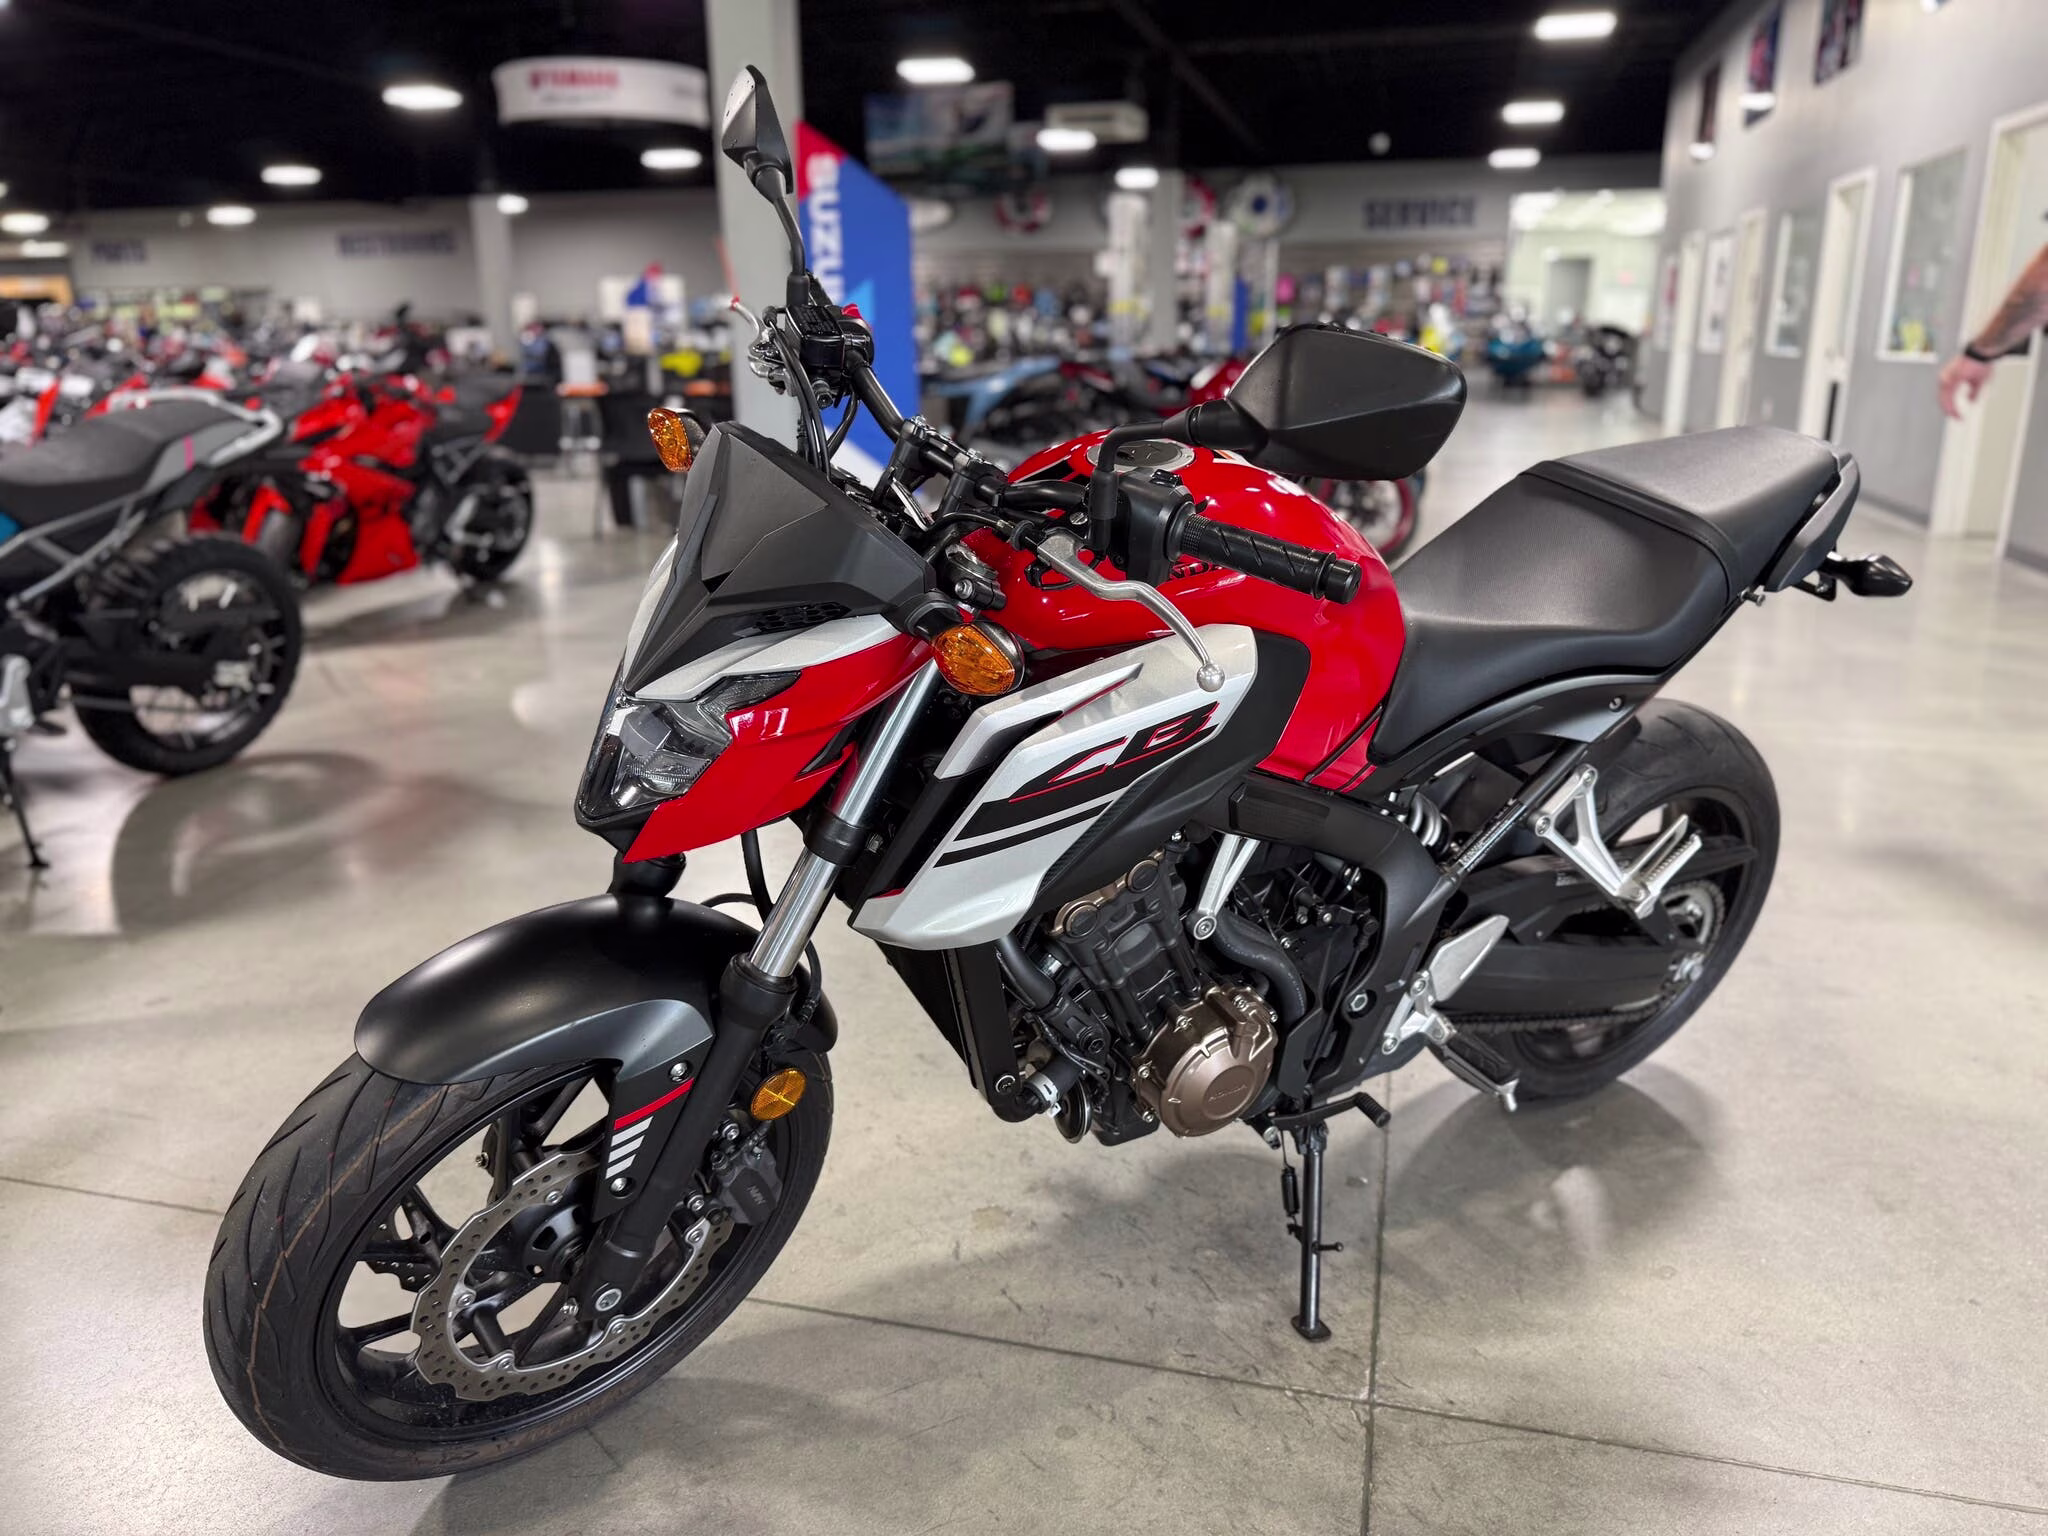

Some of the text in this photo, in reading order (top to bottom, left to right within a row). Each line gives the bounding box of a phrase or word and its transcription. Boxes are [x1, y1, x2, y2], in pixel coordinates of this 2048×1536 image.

[807, 152, 846, 304] SUZU
[1364, 198, 1474, 227] SERVICE
[1008, 700, 1220, 803] CB
